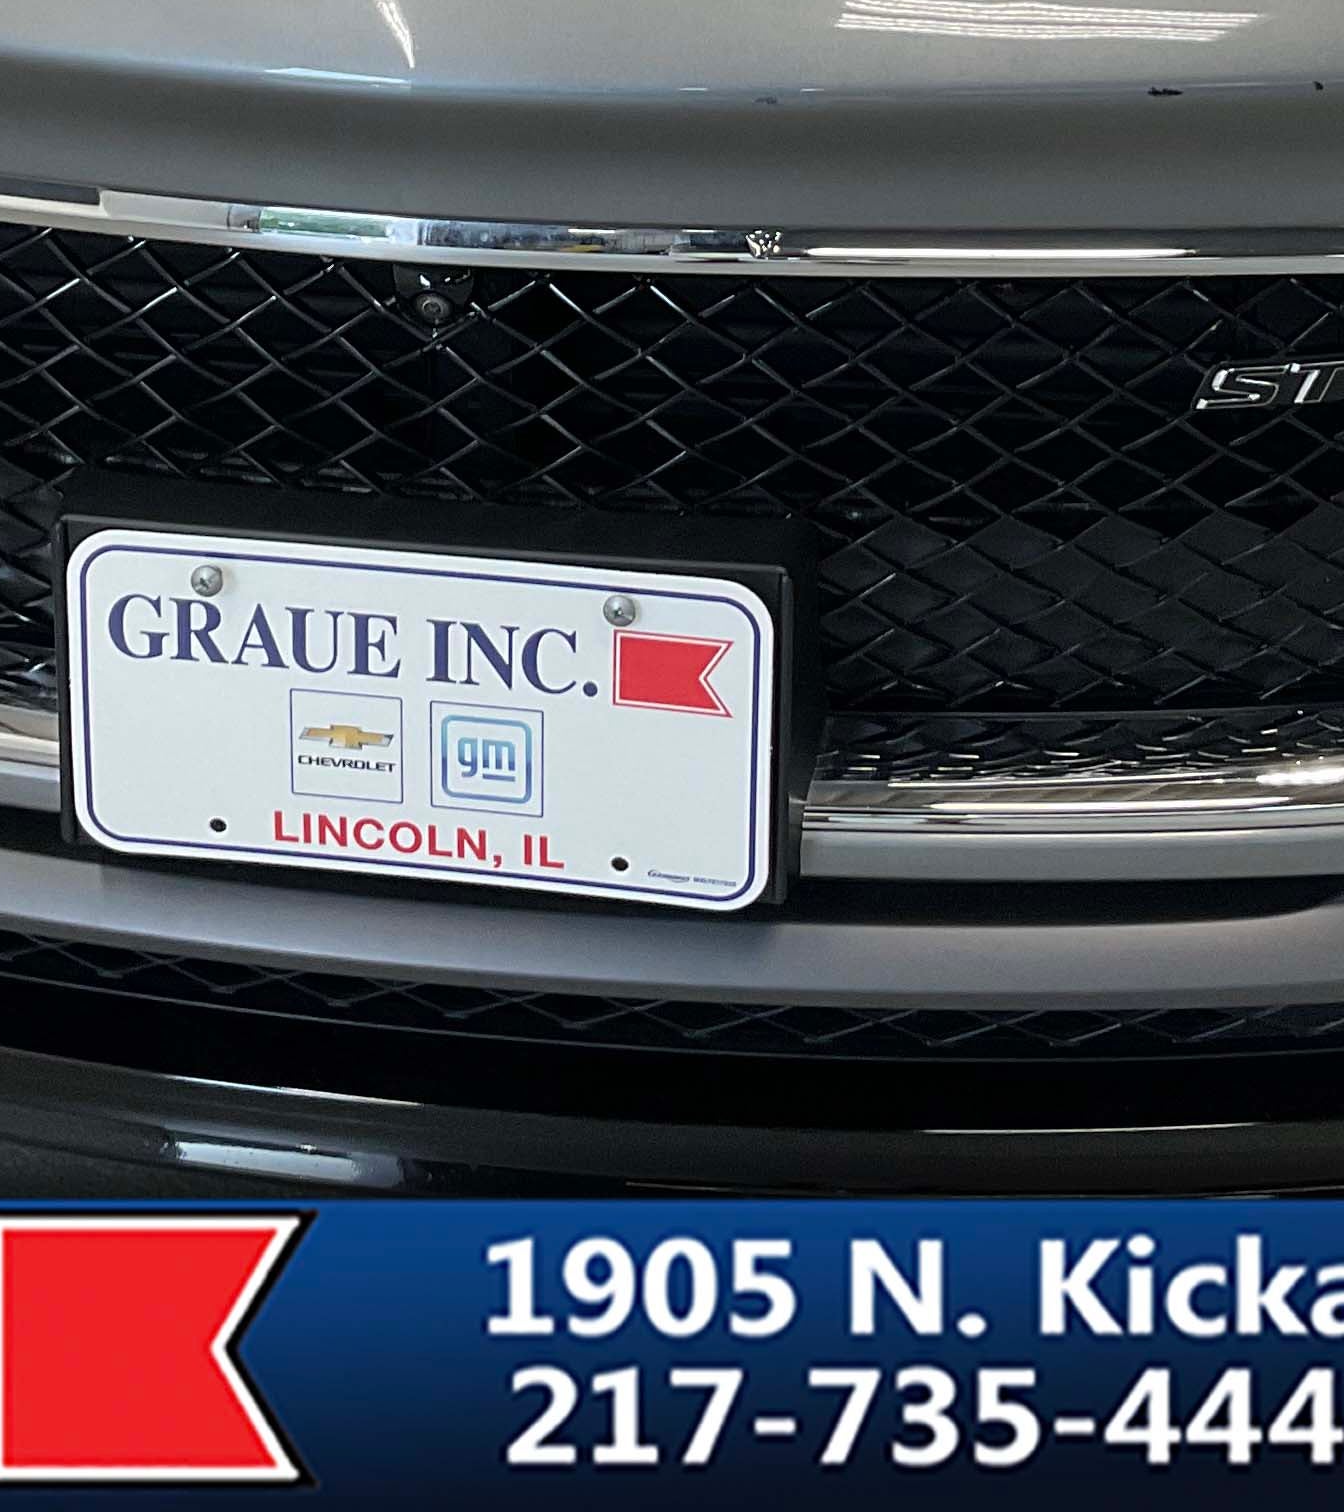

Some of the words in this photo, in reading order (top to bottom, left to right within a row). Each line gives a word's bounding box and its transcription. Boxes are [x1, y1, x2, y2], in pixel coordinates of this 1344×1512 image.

[108, 594, 400, 679] GRAUE
[426, 619, 599, 698] INC.
[297, 754, 396, 773] CHEVROLET
[457, 737, 516, 782] gm
[274, 811, 502, 868] LINCOLN,
[523, 835, 565, 869] IL
